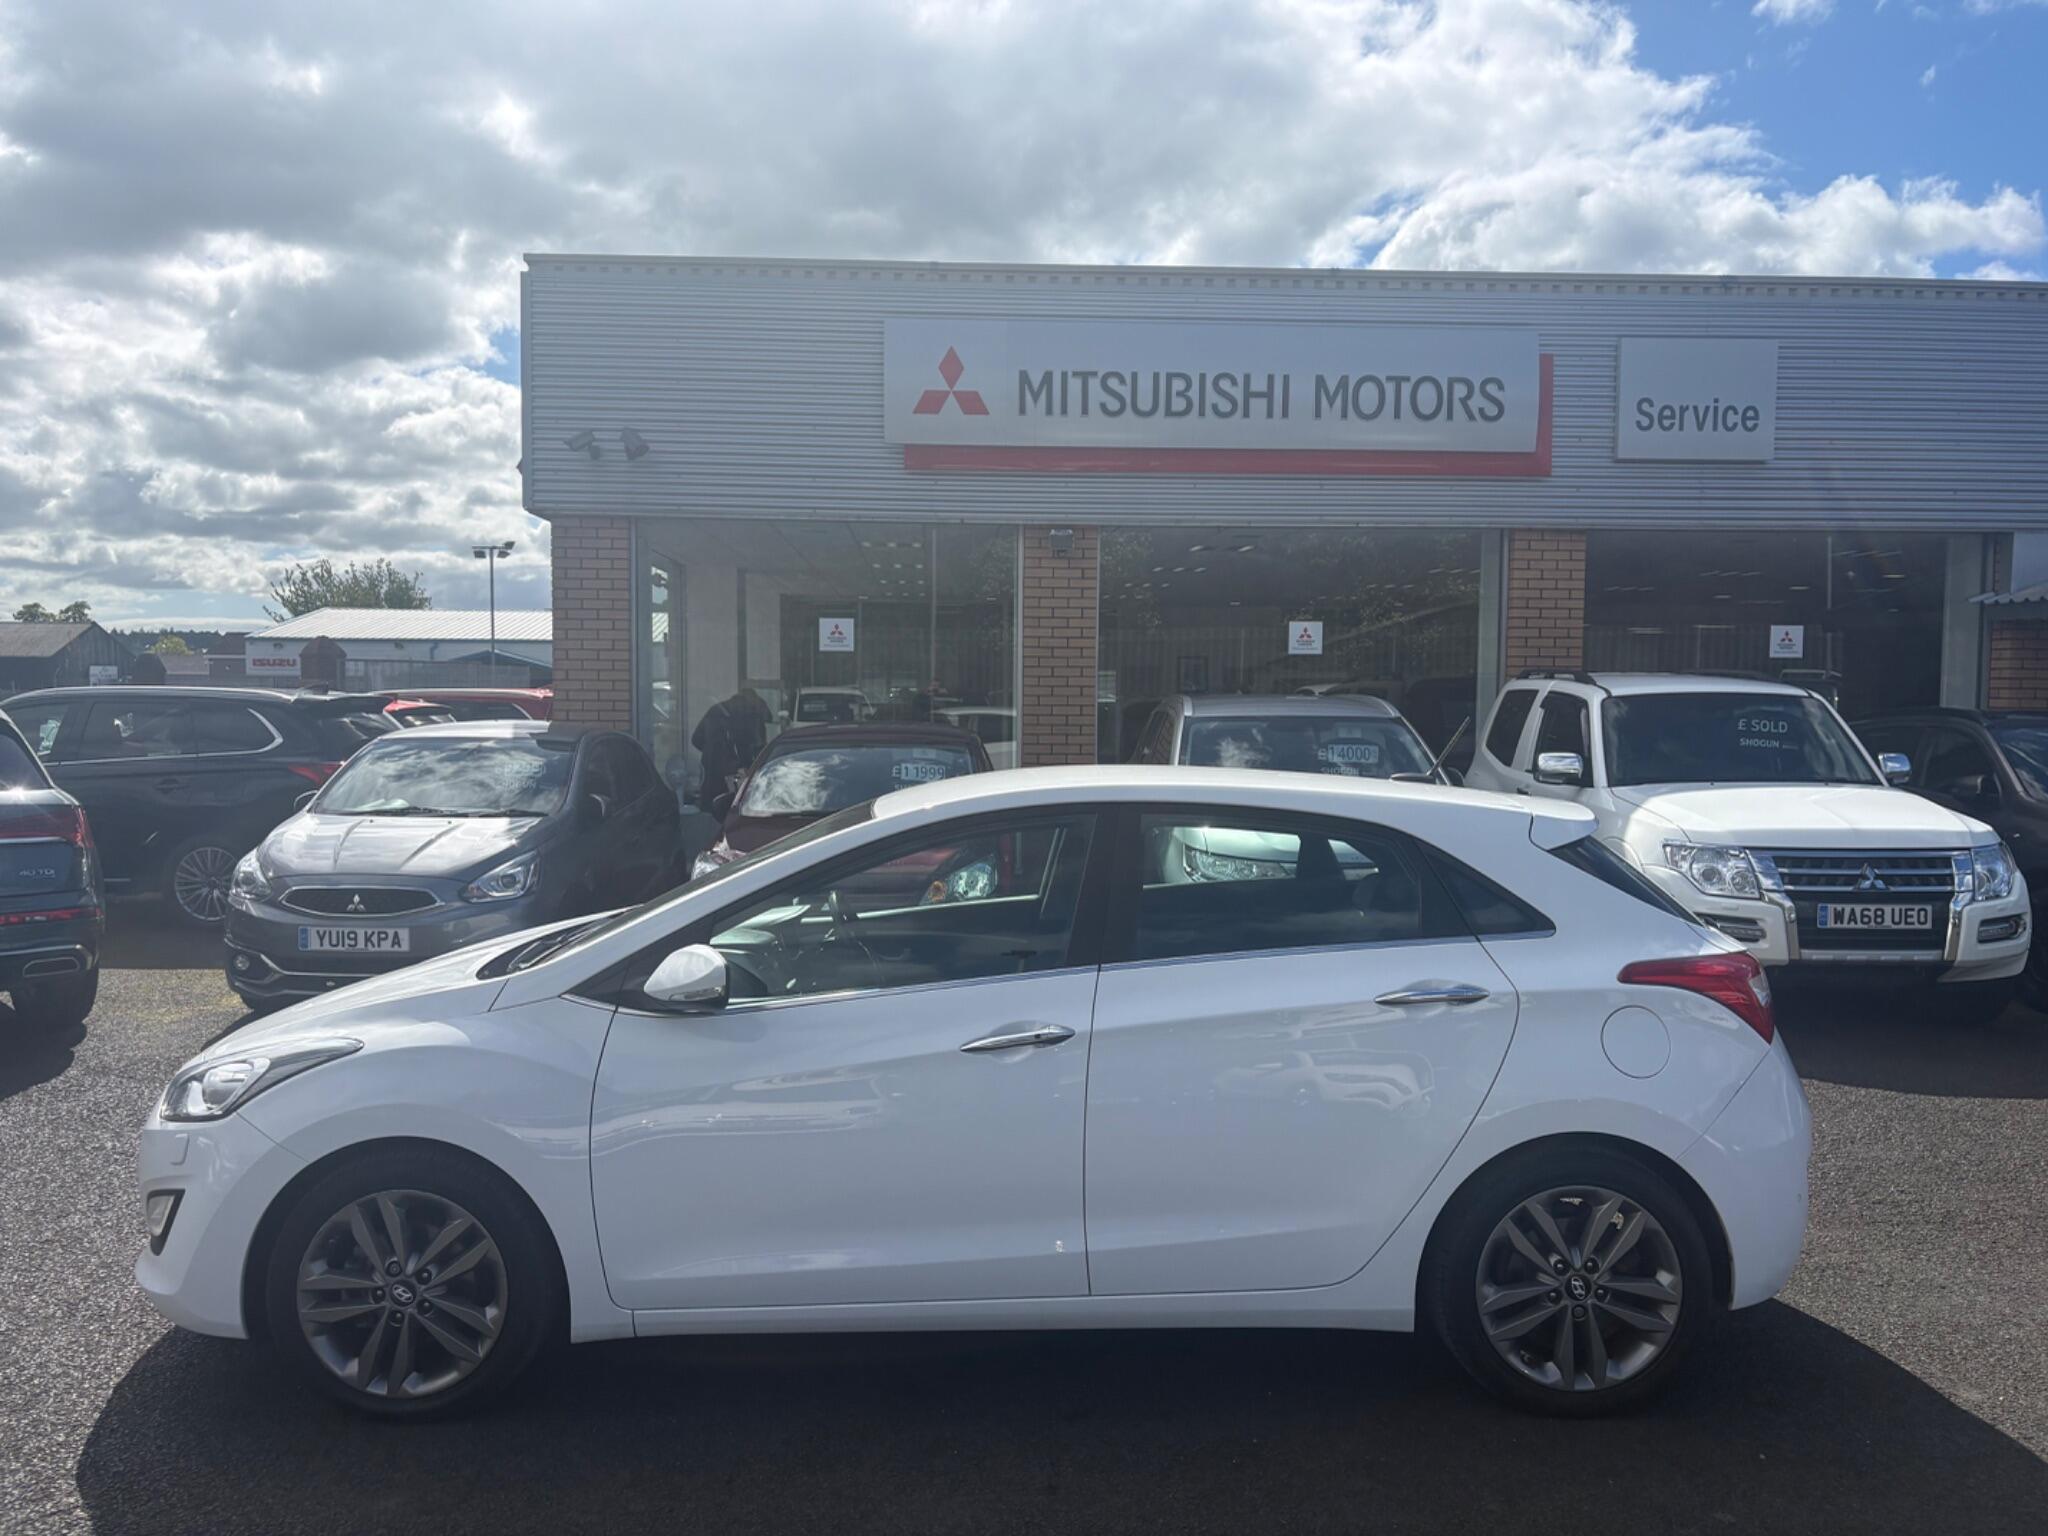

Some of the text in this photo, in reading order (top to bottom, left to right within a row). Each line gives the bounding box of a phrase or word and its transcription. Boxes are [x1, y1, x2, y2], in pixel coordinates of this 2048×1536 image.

[1017, 369, 1506, 422] MITSUBISHI MOTORS
[1635, 396, 1761, 433] Service
[251, 657, 297, 668] ISUZU
[1750, 718, 1789, 733] SOLD
[1739, 737, 1780, 749] SHOGUN
[1833, 907, 1929, 926] WA68 UEO
[316, 929, 402, 949] YU19 KPA
